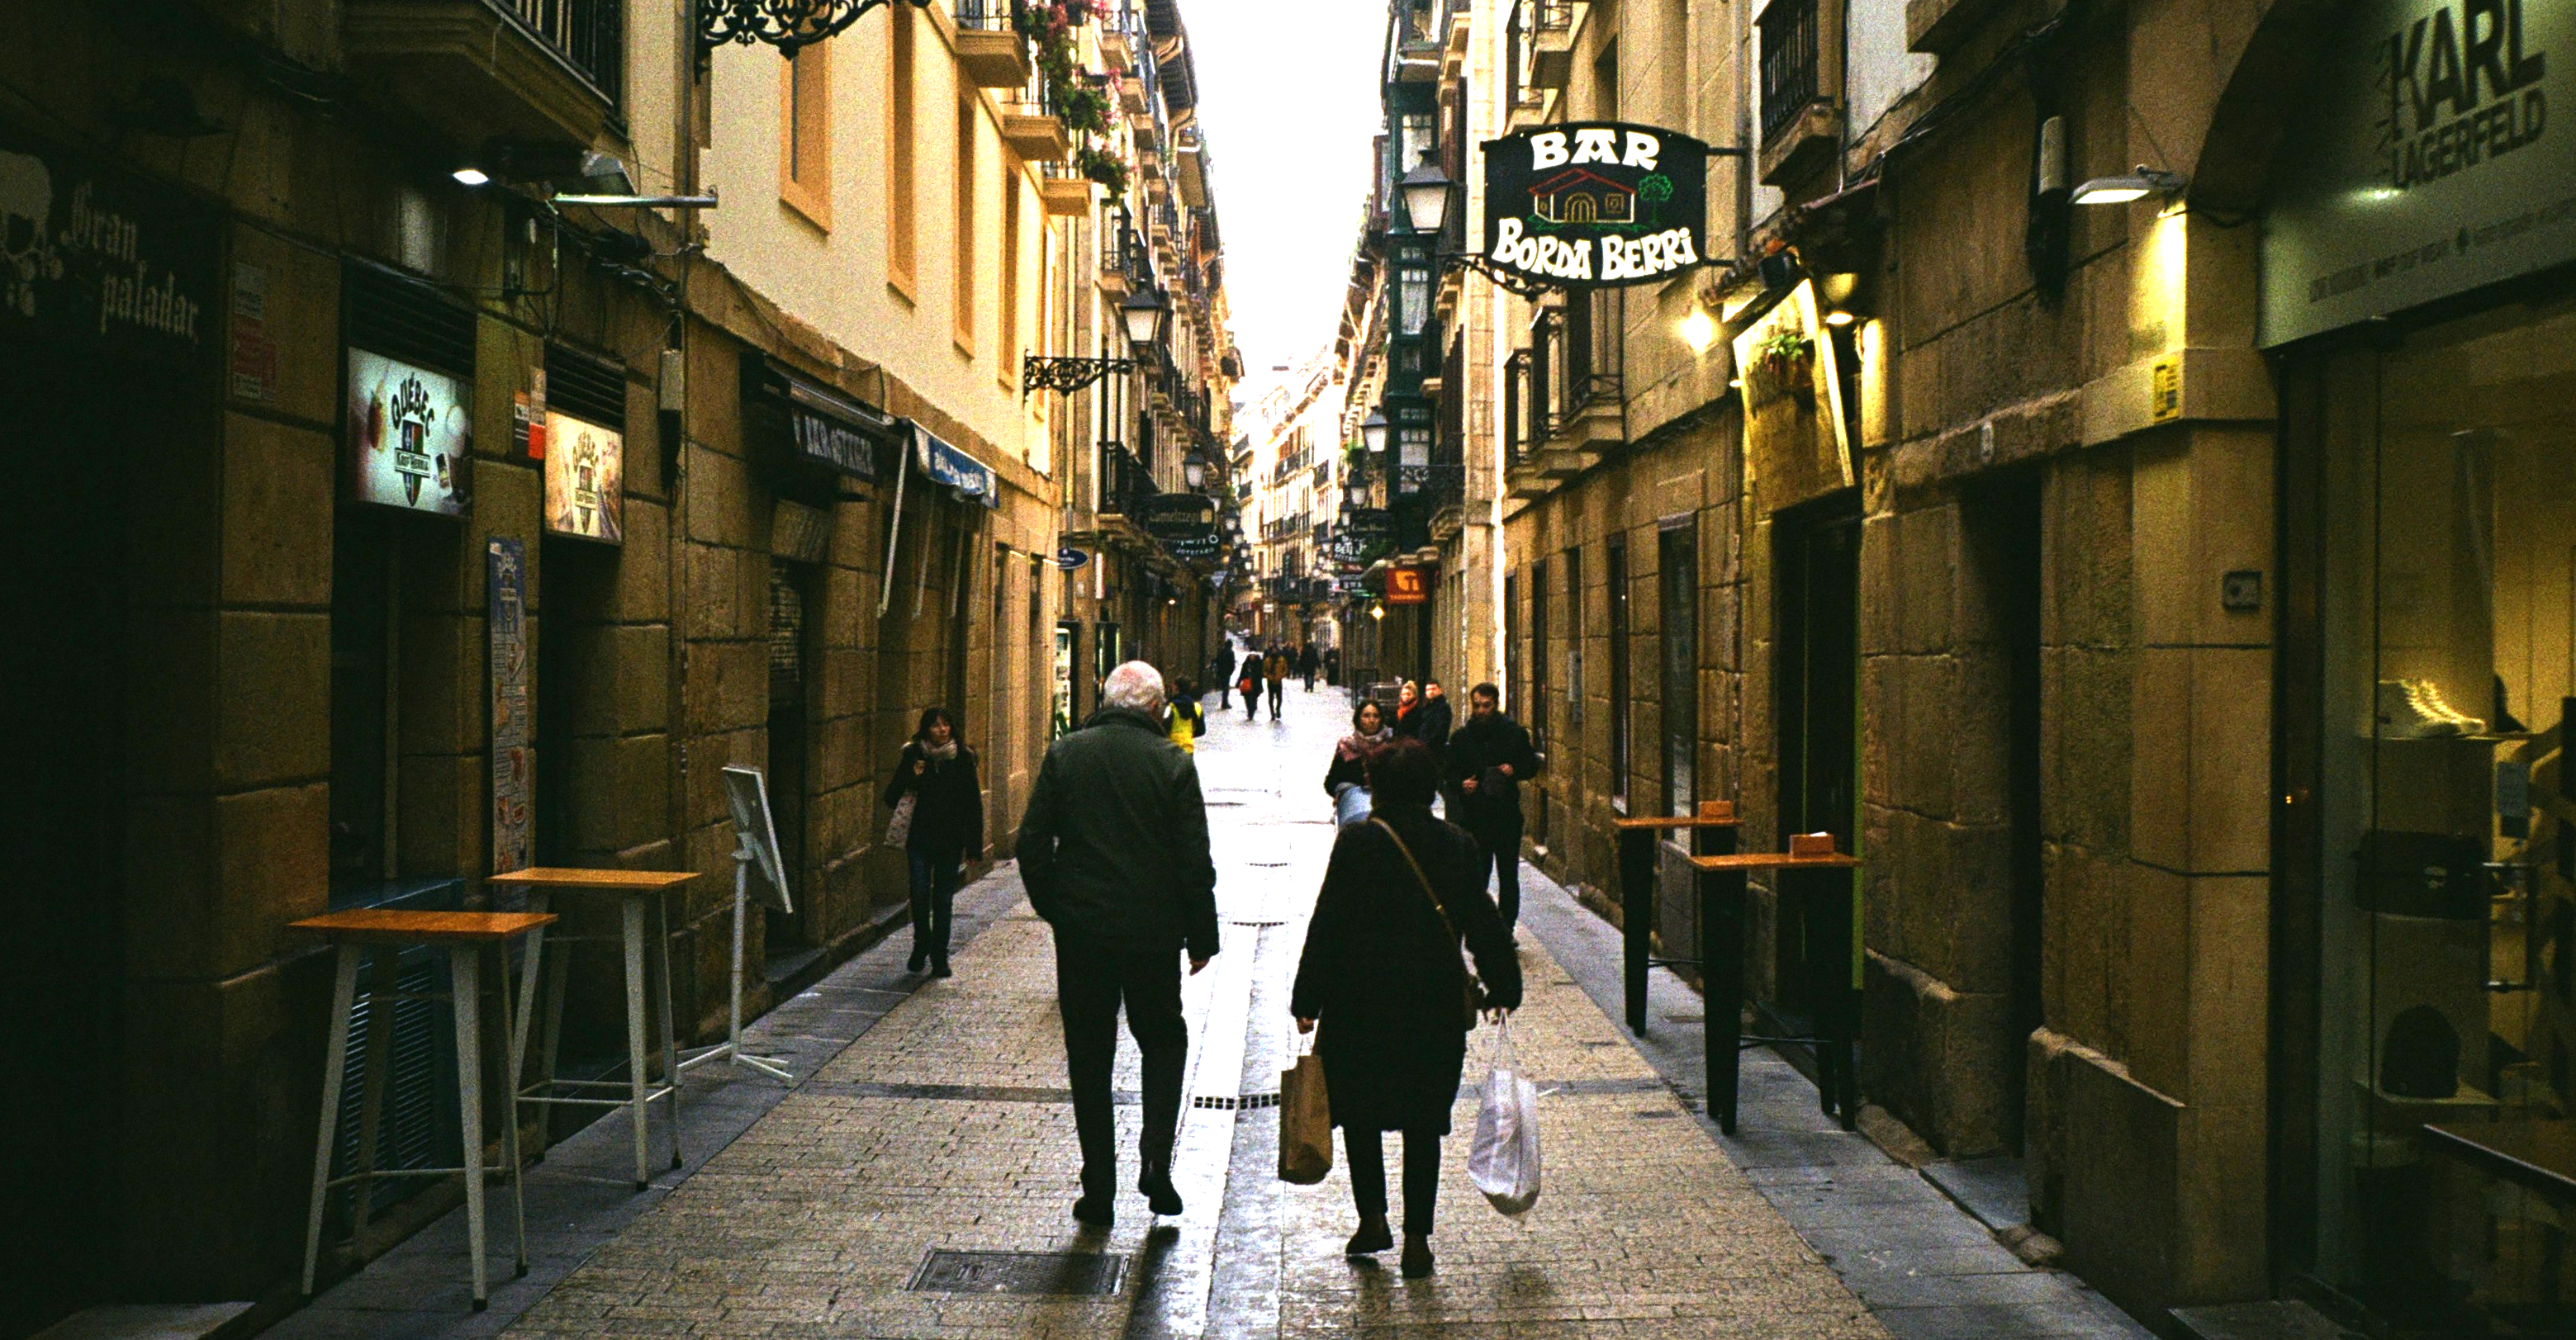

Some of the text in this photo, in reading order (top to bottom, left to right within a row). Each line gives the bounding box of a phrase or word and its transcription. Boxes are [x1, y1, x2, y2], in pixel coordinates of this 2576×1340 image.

[2391, 0, 2546, 142] KARL
[1530, 129, 1660, 171] BAR
[2393, 88, 2546, 189] LAGERFELD
[60, 181, 137, 263] Gran
[1492, 217, 1592, 279] BORDA
[100, 260, 199, 339] paladar
[391, 372, 434, 437] QUÉBEC
